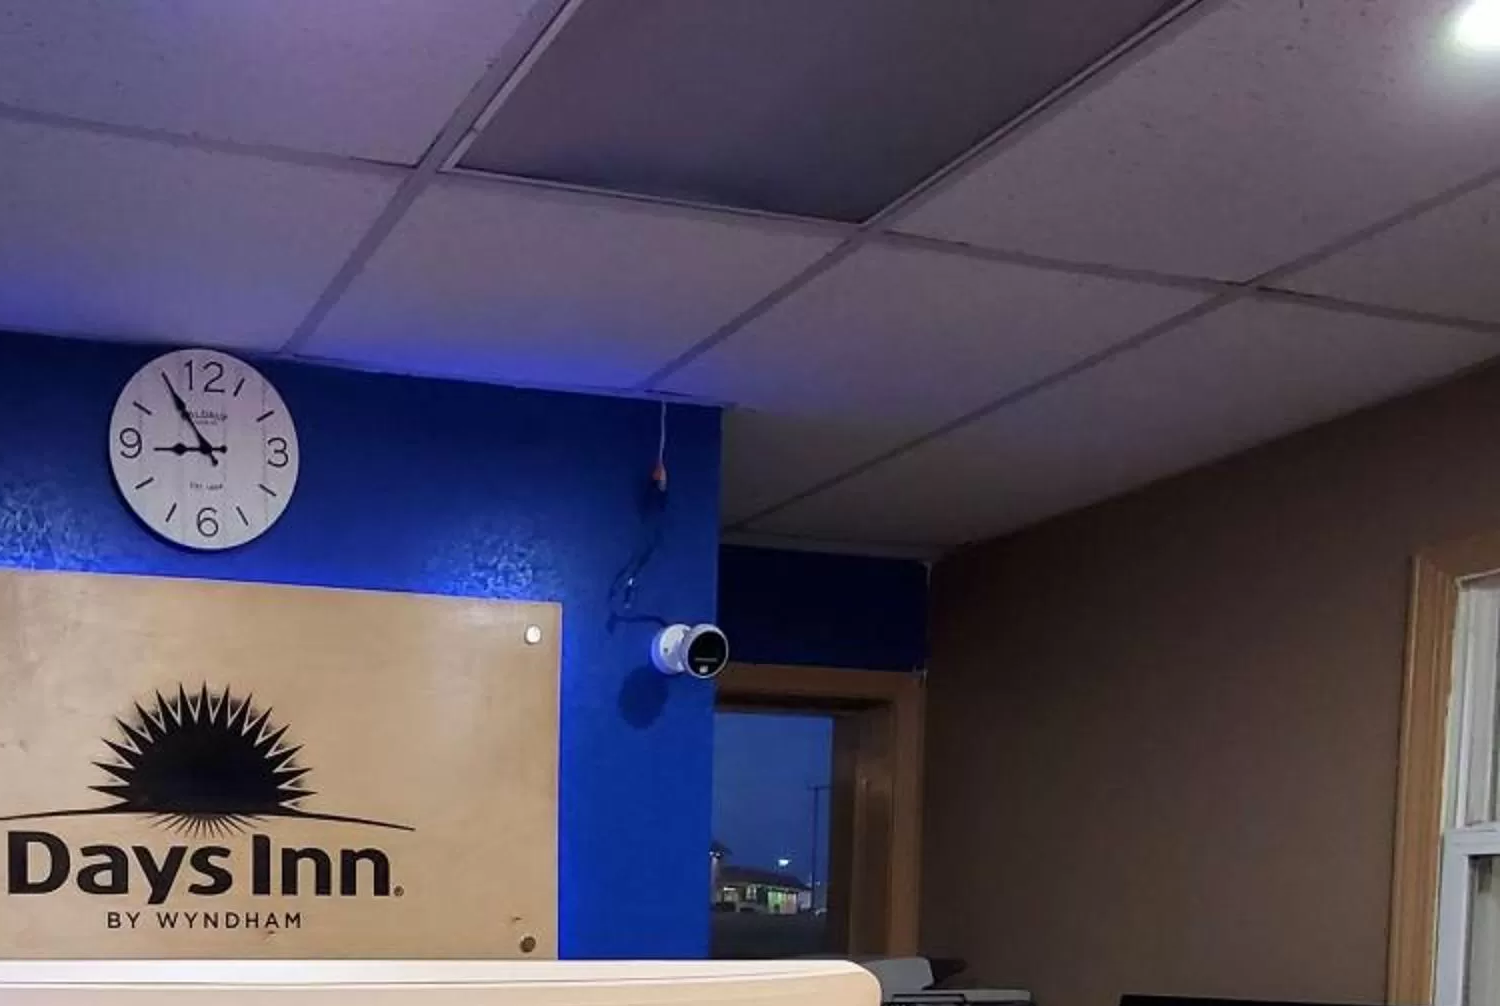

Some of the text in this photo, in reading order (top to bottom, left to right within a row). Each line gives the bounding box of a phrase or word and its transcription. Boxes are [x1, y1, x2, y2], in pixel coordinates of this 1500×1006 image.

[183, 360, 225, 393] 12
[119, 427, 143, 459] 9
[267, 437, 289, 468] 3
[196, 507, 219, 537] 6
[7, 831, 233, 905] Days
[107, 911, 302, 930] BY WYNDHAM
